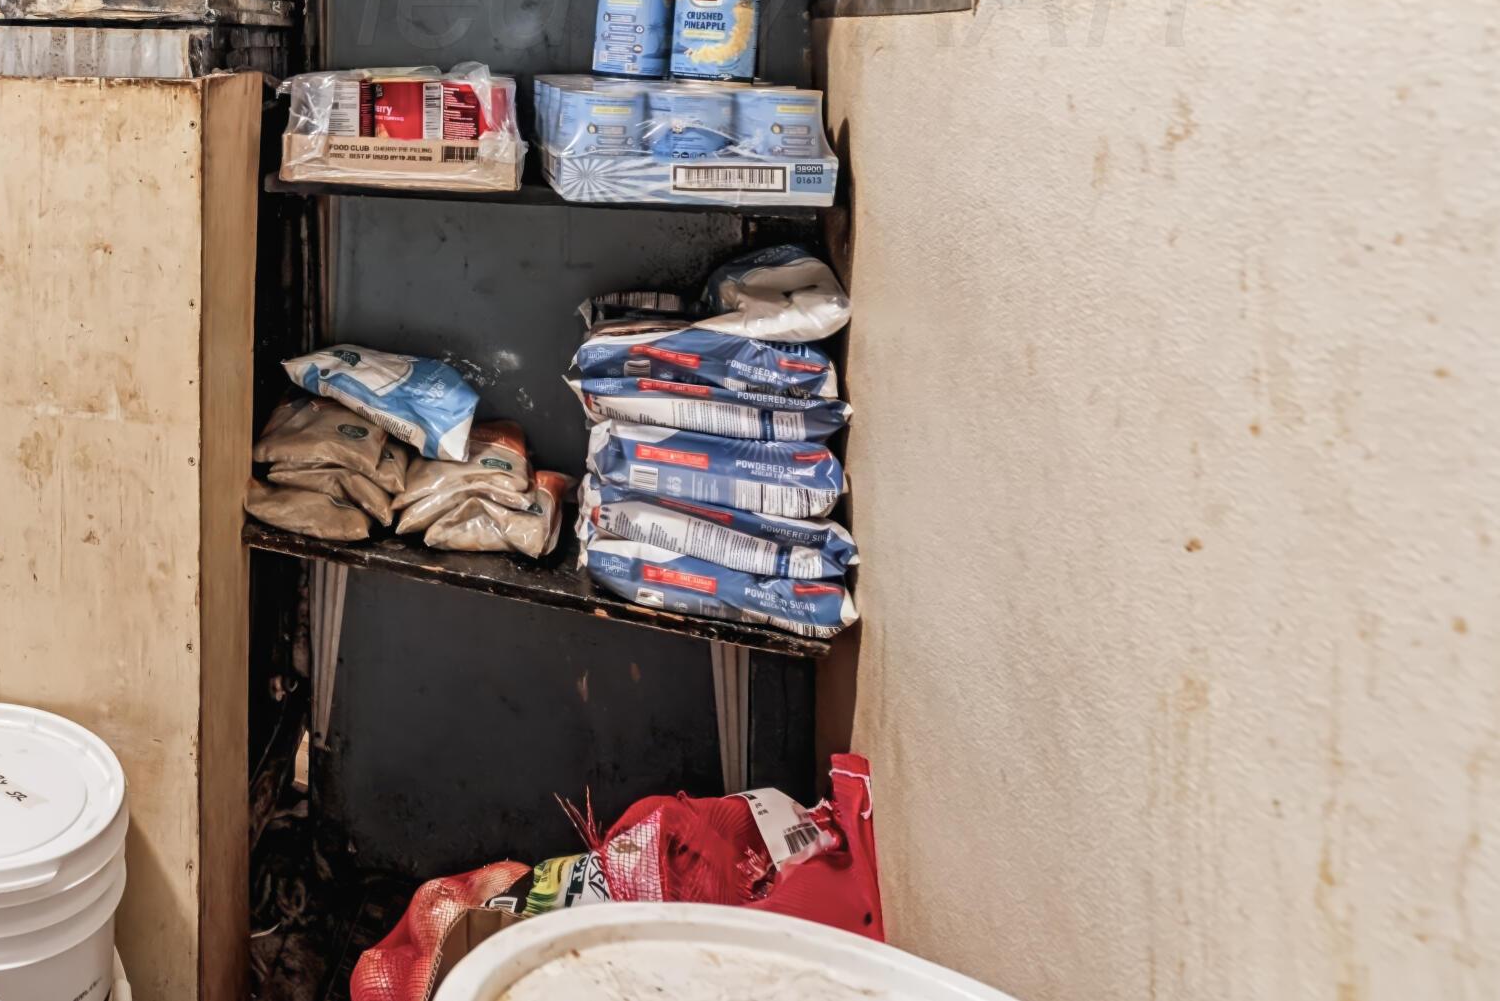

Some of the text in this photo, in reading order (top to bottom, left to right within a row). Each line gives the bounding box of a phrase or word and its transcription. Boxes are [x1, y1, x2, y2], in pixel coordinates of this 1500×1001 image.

[686, 11, 723, 21] CRUSHED
[684, 21, 726, 31] PINEAPPLE
[329, 143, 349, 151] FOOD
[372, 153, 389, 161] USED
[796, 165, 823, 174] 38900
[796, 176, 823, 184] 01613
[725, 359, 771, 378] POWDERED
[737, 391, 786, 405] POWDERED
[735, 459, 785, 474] POWDERED
[760, 523, 810, 542] POWDERED
[789, 599, 816, 614] SUGAR
